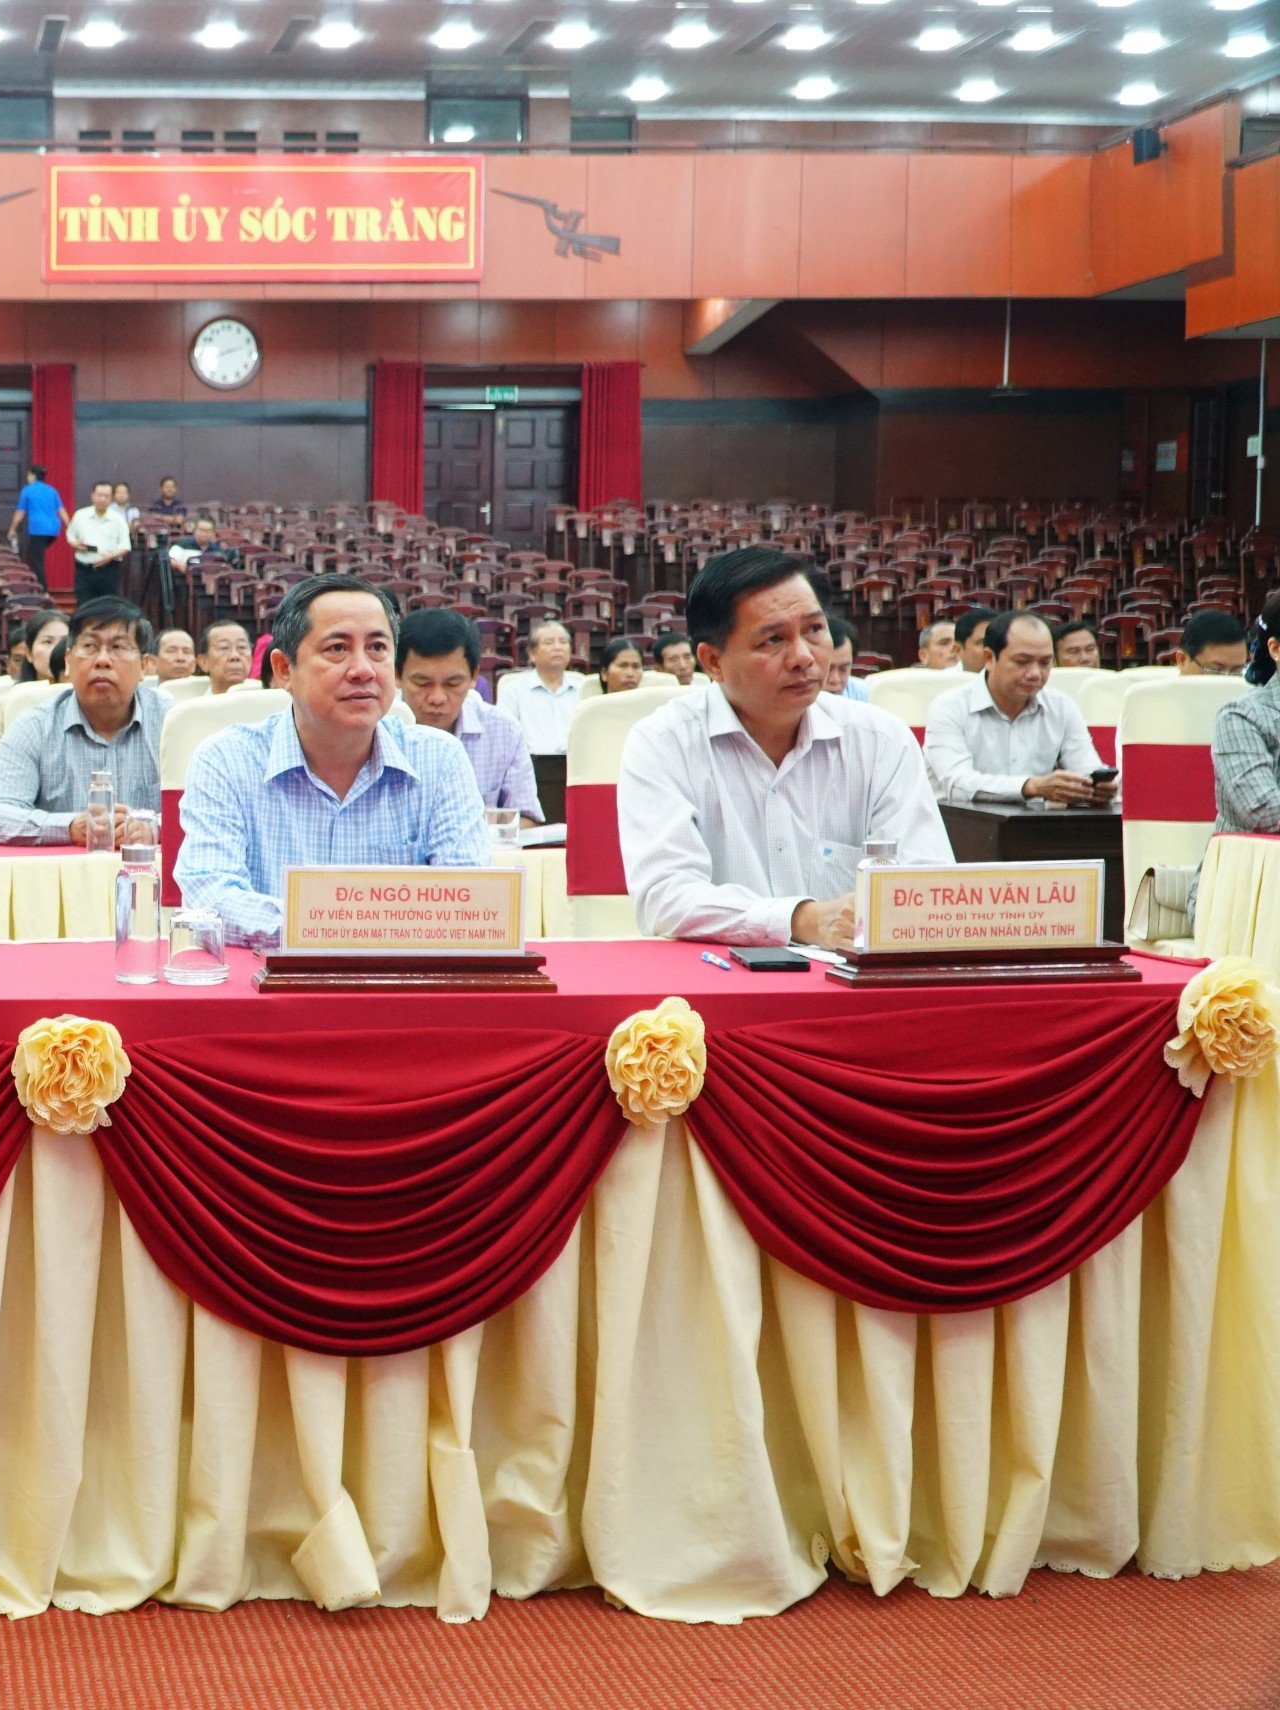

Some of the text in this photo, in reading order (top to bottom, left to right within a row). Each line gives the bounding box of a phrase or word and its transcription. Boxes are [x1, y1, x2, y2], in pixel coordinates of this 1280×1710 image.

[59, 193, 467, 242] TỈNH ỦY SÓC TRĂNG
[335, 886, 364, 902] Đ/c
[370, 884, 411, 902] NGÔ
[893, 888, 924, 907] Đ/c
[989, 882, 1030, 905] VĂN
[1037, 881, 1076, 904] LÂU
[357, 910, 380, 920] BAN
[436, 910, 451, 923] VỤ
[352, 928, 369, 939] BAN
[468, 928, 486, 939] NAM
[964, 926, 987, 938] BAN
